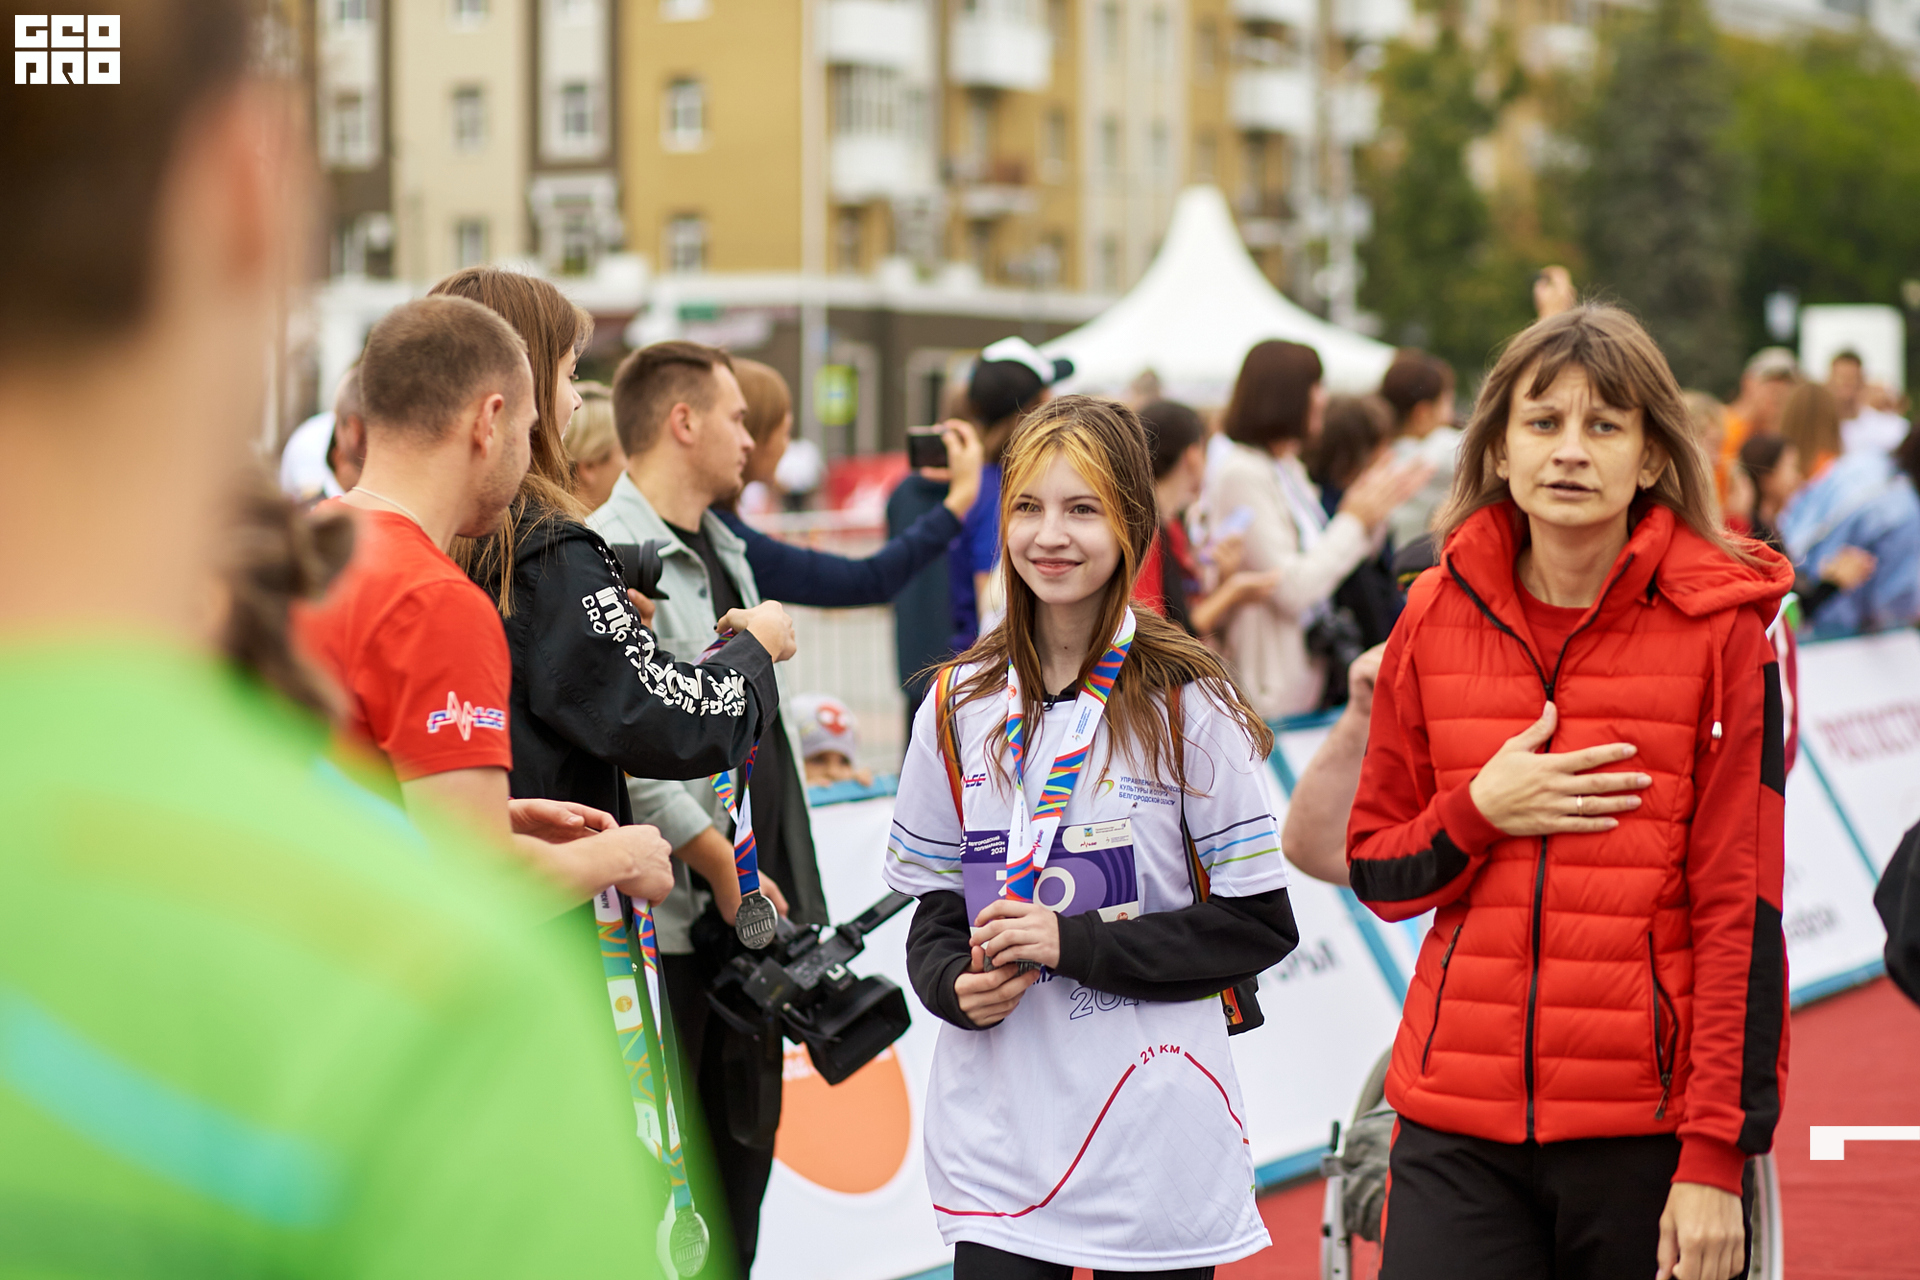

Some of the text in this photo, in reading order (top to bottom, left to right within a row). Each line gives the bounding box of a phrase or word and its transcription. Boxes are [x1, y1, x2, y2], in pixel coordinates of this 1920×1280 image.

[1119, 791, 1160, 804] БЕЛГОРОДСКОЙ
[990, 846, 1006, 856] 2021
[1140, 1046, 1155, 1064] 21
